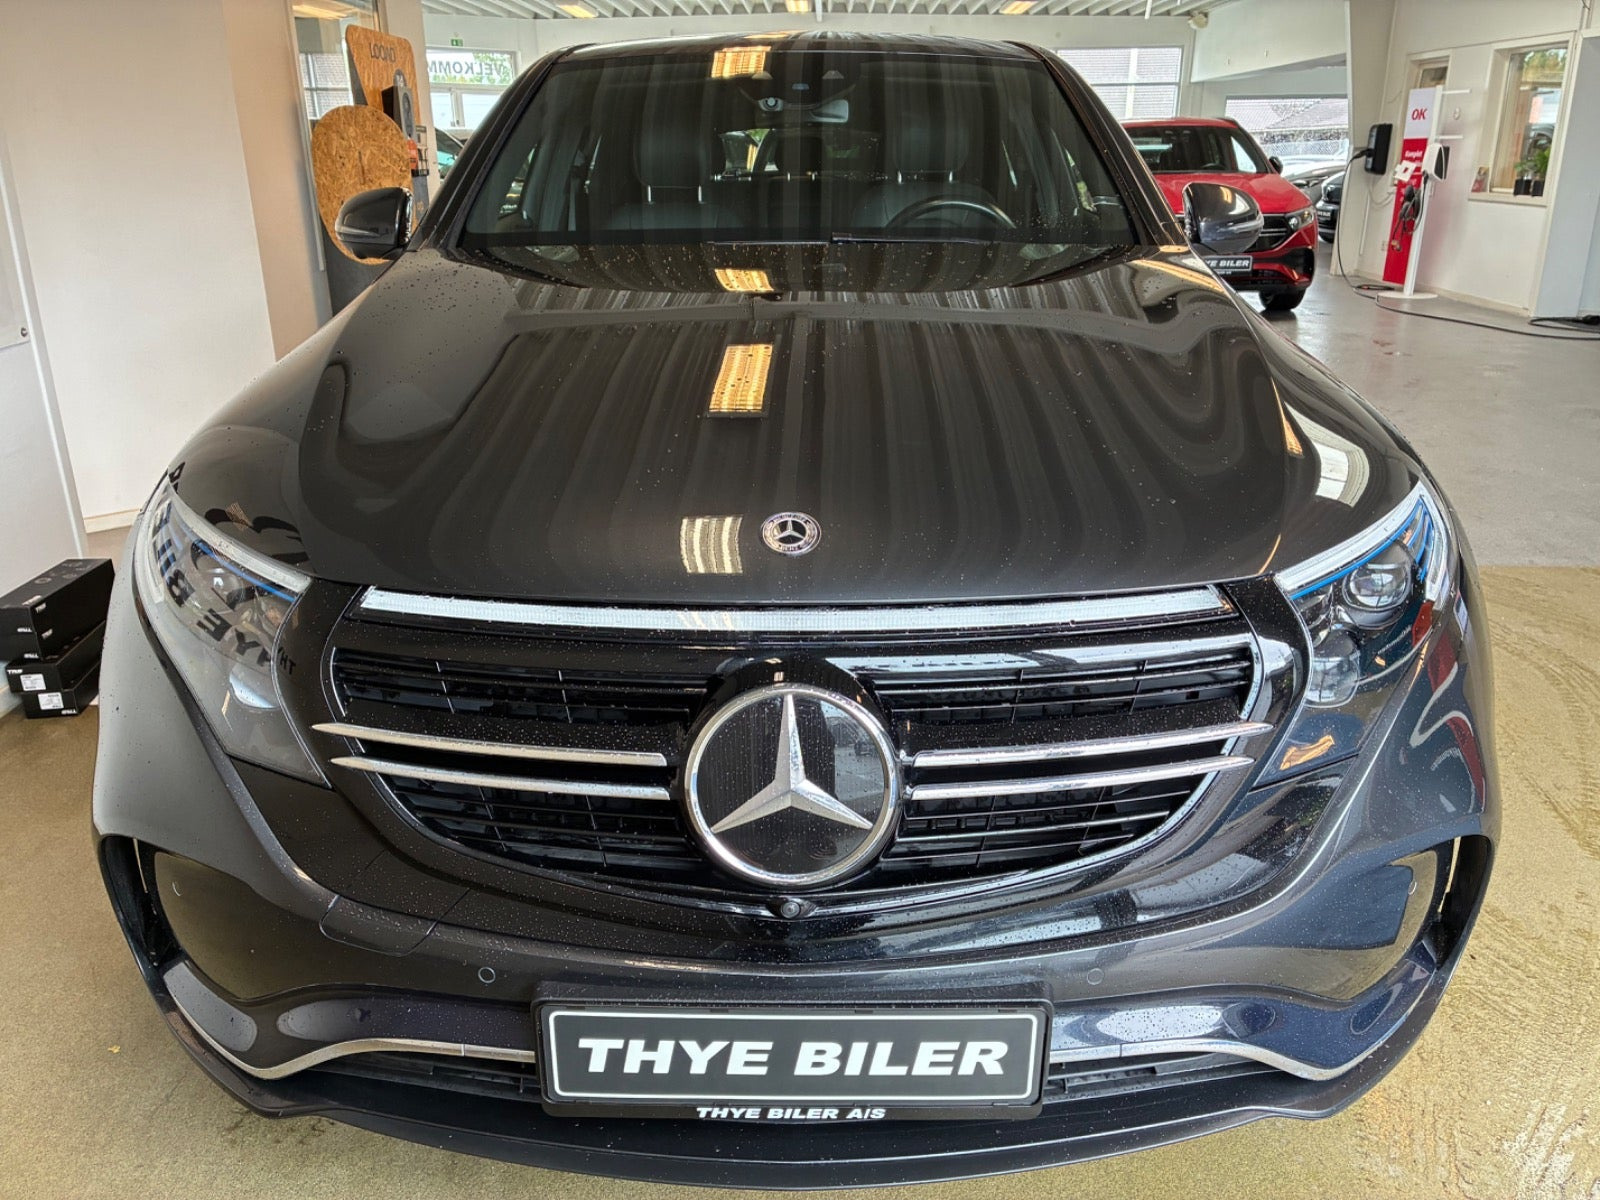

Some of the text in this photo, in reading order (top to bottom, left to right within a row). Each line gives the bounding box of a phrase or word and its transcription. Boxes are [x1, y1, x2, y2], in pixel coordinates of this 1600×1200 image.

[1411, 108, 1427, 120] OK
[1219, 260, 1250, 268] BILER
[578, 1038, 1009, 1076] THYE BILER
[696, 1107, 887, 1120] THYE BILER A/S
